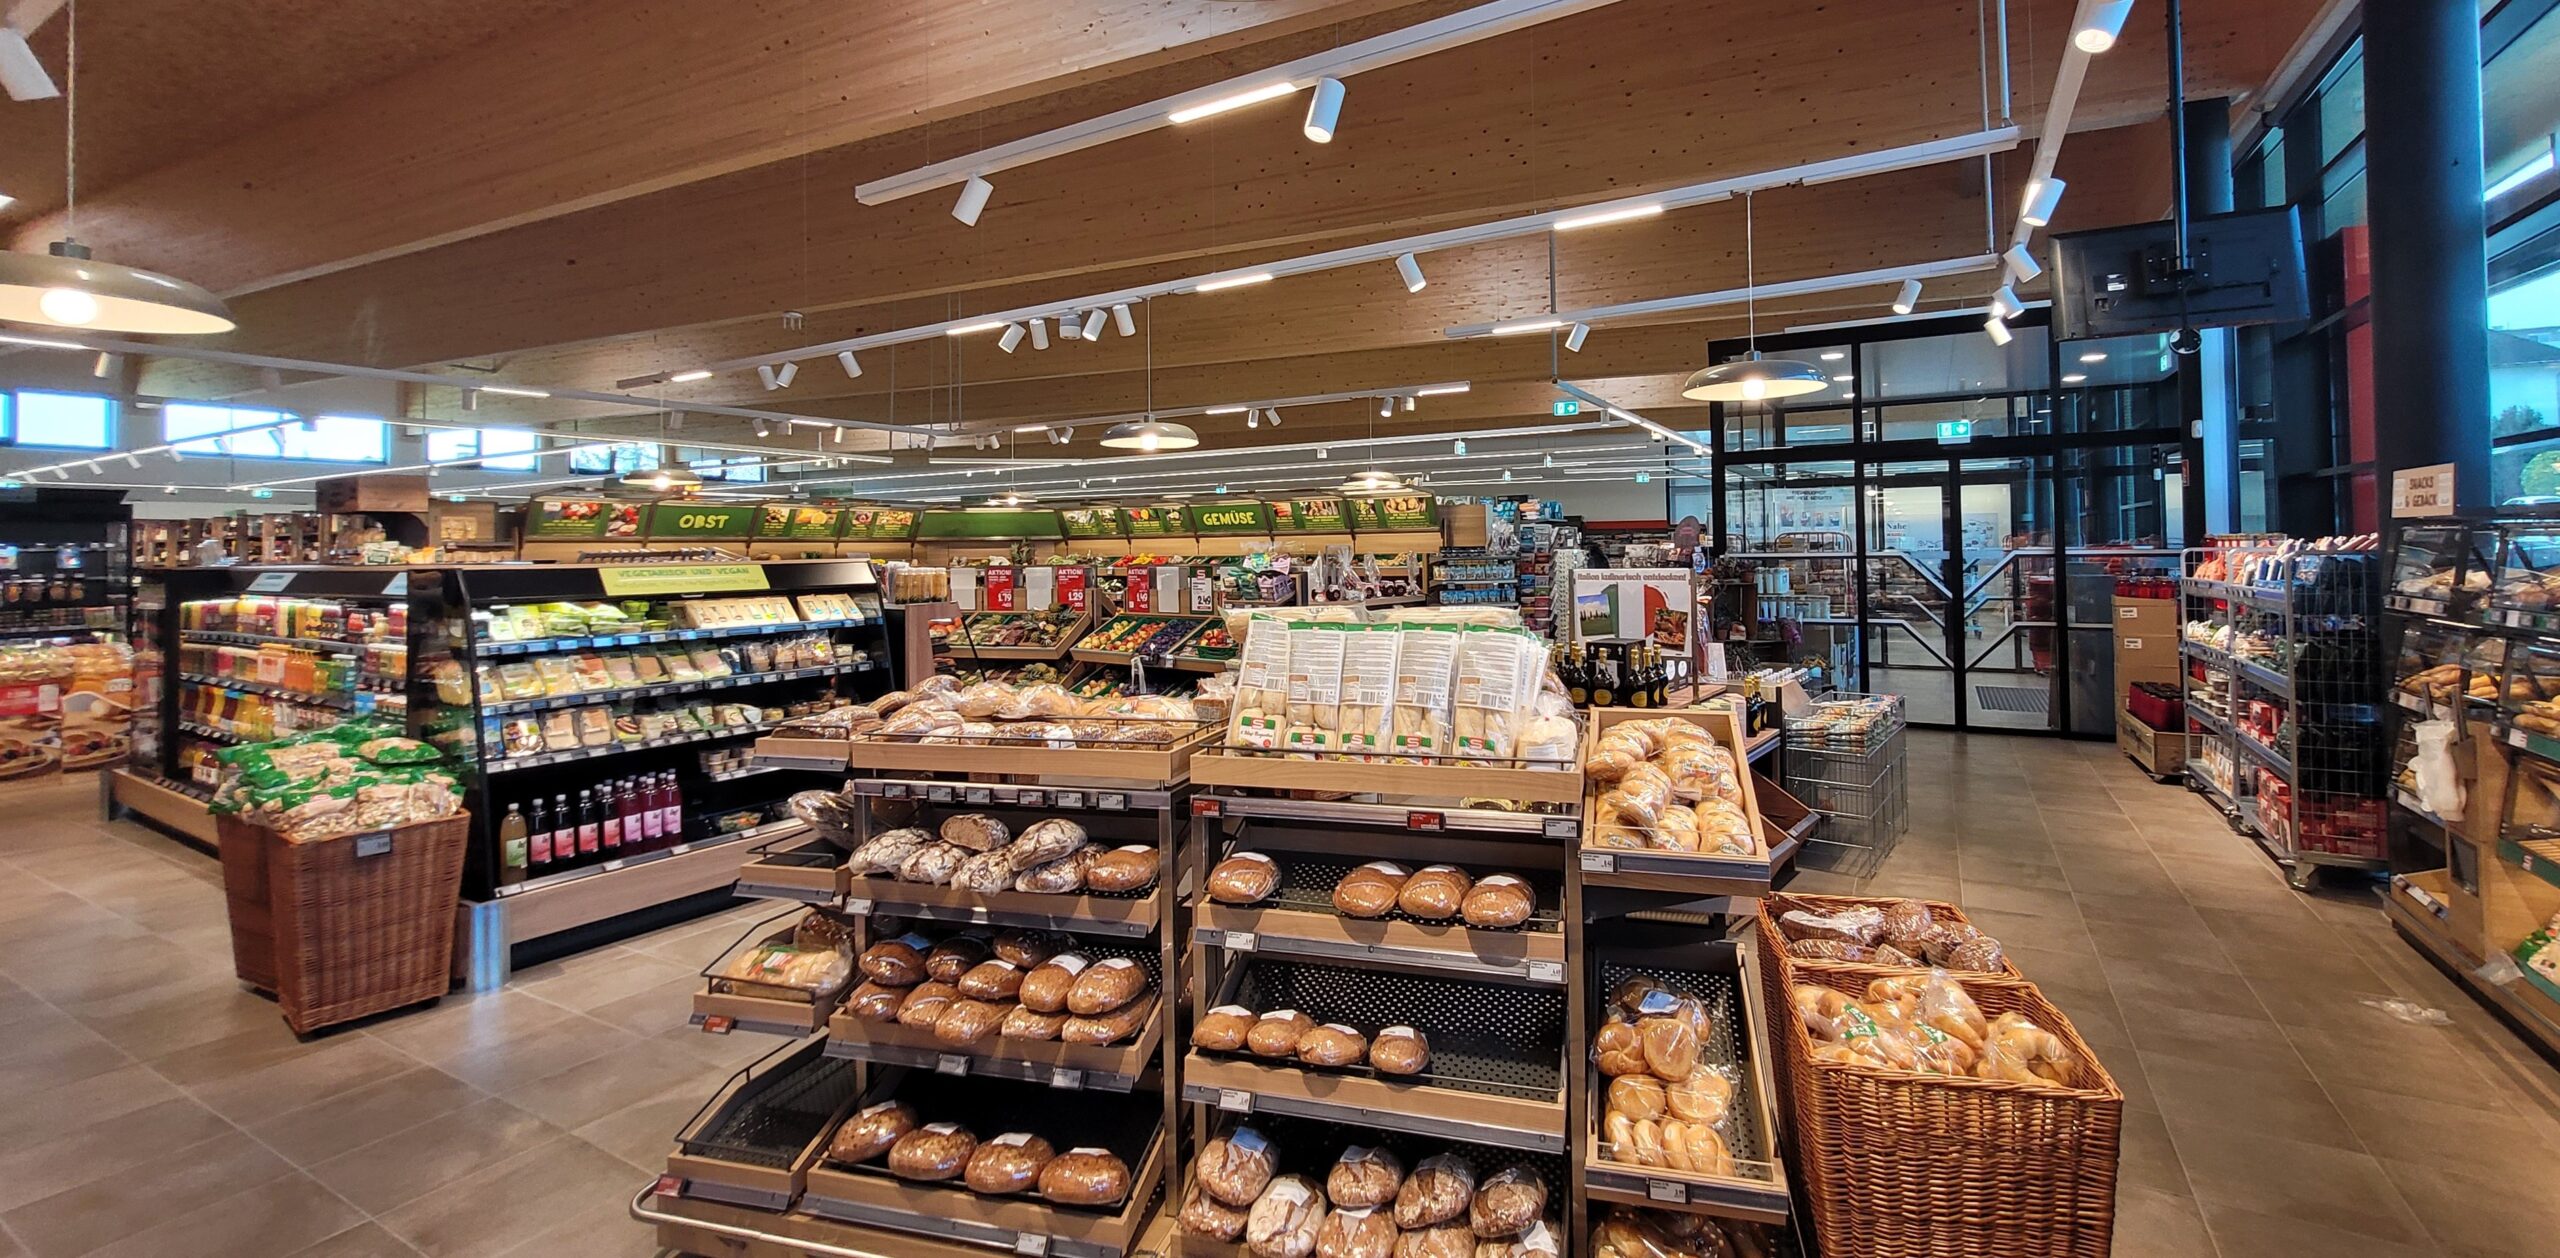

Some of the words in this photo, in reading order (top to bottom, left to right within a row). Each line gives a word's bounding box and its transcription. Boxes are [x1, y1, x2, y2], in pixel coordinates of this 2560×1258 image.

[2409, 476, 2434, 490] SNACKS
[679, 514, 730, 529] OBST
[1203, 510, 1256, 526] GEMÜSE
[617, 568, 688, 578] VEGETARISCH
[692, 567, 713, 576] UND
[717, 567, 750, 575] VEGAN
[1578, 573, 1600, 581] Italien
[1601, 573, 1641, 581] kulinarisch
[1643, 573, 1687, 581] entdecken!
